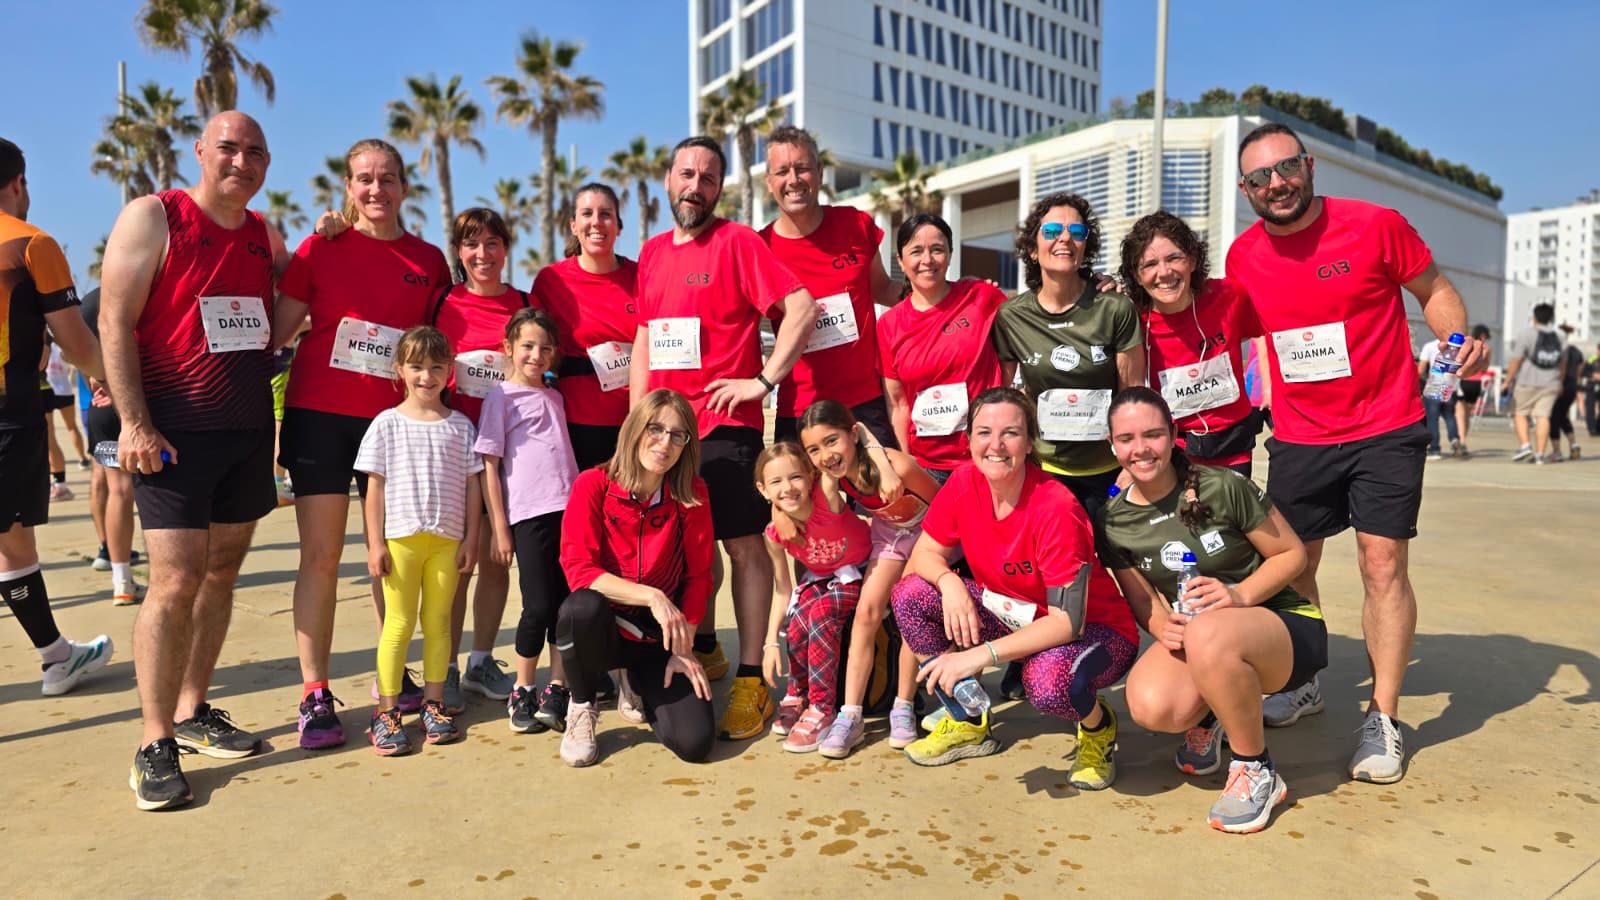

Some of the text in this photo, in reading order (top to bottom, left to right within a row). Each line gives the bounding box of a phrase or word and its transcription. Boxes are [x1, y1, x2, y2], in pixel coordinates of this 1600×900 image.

[218, 317, 262, 329] DAVID
[815, 313, 847, 330] ORDI
[1291, 346, 1335, 360] JUANMA
[606, 357, 632, 370] LAUR
[467, 366, 506, 381] GEMMA
[921, 404, 959, 417] SUSANA
